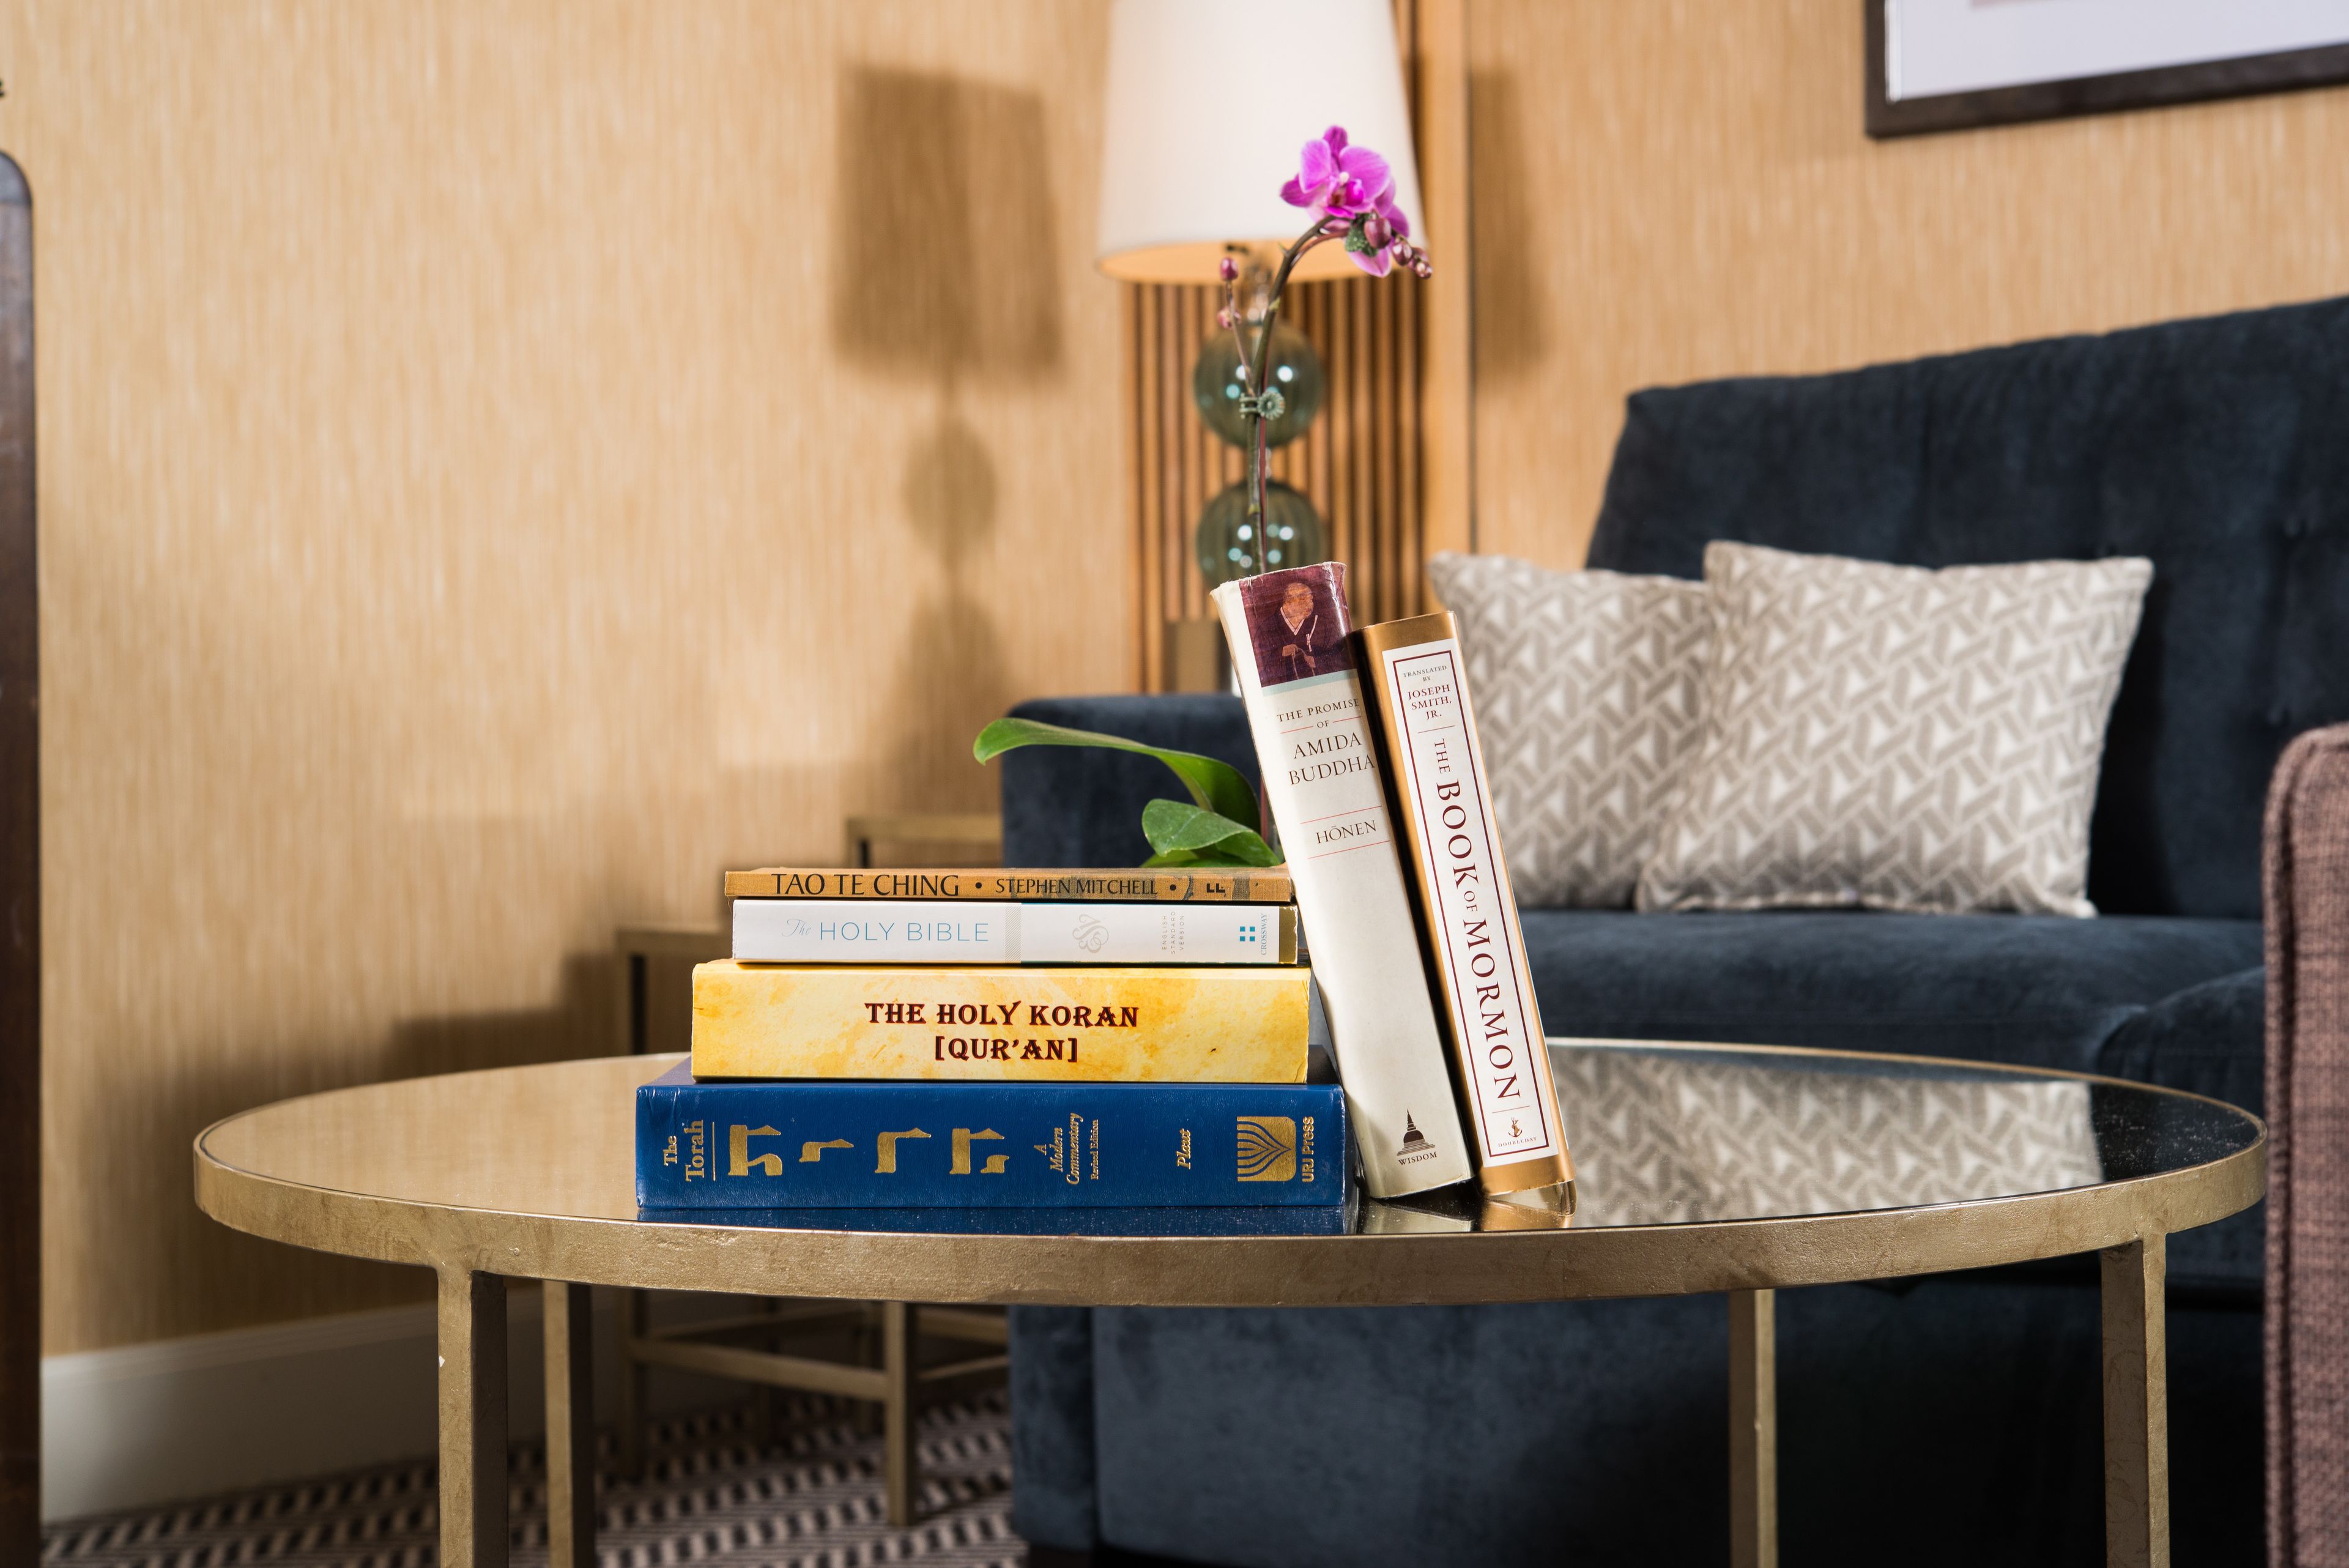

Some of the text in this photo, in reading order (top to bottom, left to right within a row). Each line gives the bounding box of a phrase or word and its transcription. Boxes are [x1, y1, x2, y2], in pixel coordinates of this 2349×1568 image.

[1403, 665, 1447, 678] TRANSLATED
[1408, 684, 1450, 700] JOSEPH
[1411, 696, 1452, 710] SMITH,
[1277, 698, 1360, 723] THE PROMISE
[1425, 710, 1442, 720] JR.
[1317, 720, 1329, 729] OF
[1294, 732, 1362, 759] AMIDA
[1289, 754, 1375, 785] BUDDHA
[1316, 820, 1378, 844] HŌNEN
[771, 873, 1159, 896] TAO TE CHING STEPHEN MITCHELL
[782, 918, 989, 942] The HOLY BIBLE
[1434, 738, 1521, 1099] THE BOOK OF MORMON
[864, 1000, 1139, 1028] THE HOLY KORAN
[663, 1135, 678, 1167] The
[684, 1119, 705, 1183] Torah
[1034, 1145, 1047, 1155] A
[1050, 1127, 1063, 1173] Modern
[1066, 1112, 1083, 1185] Commentary
[1090, 1119, 1099, 1180] Revised Edition
[1175, 1128, 1191, 1170] Plaut
[1302, 1116, 1315, 1183] URJ Press
[1497, 1136, 1537, 1148] DOUBLEDAY
[1398, 1151, 1438, 1165] WISDOM
